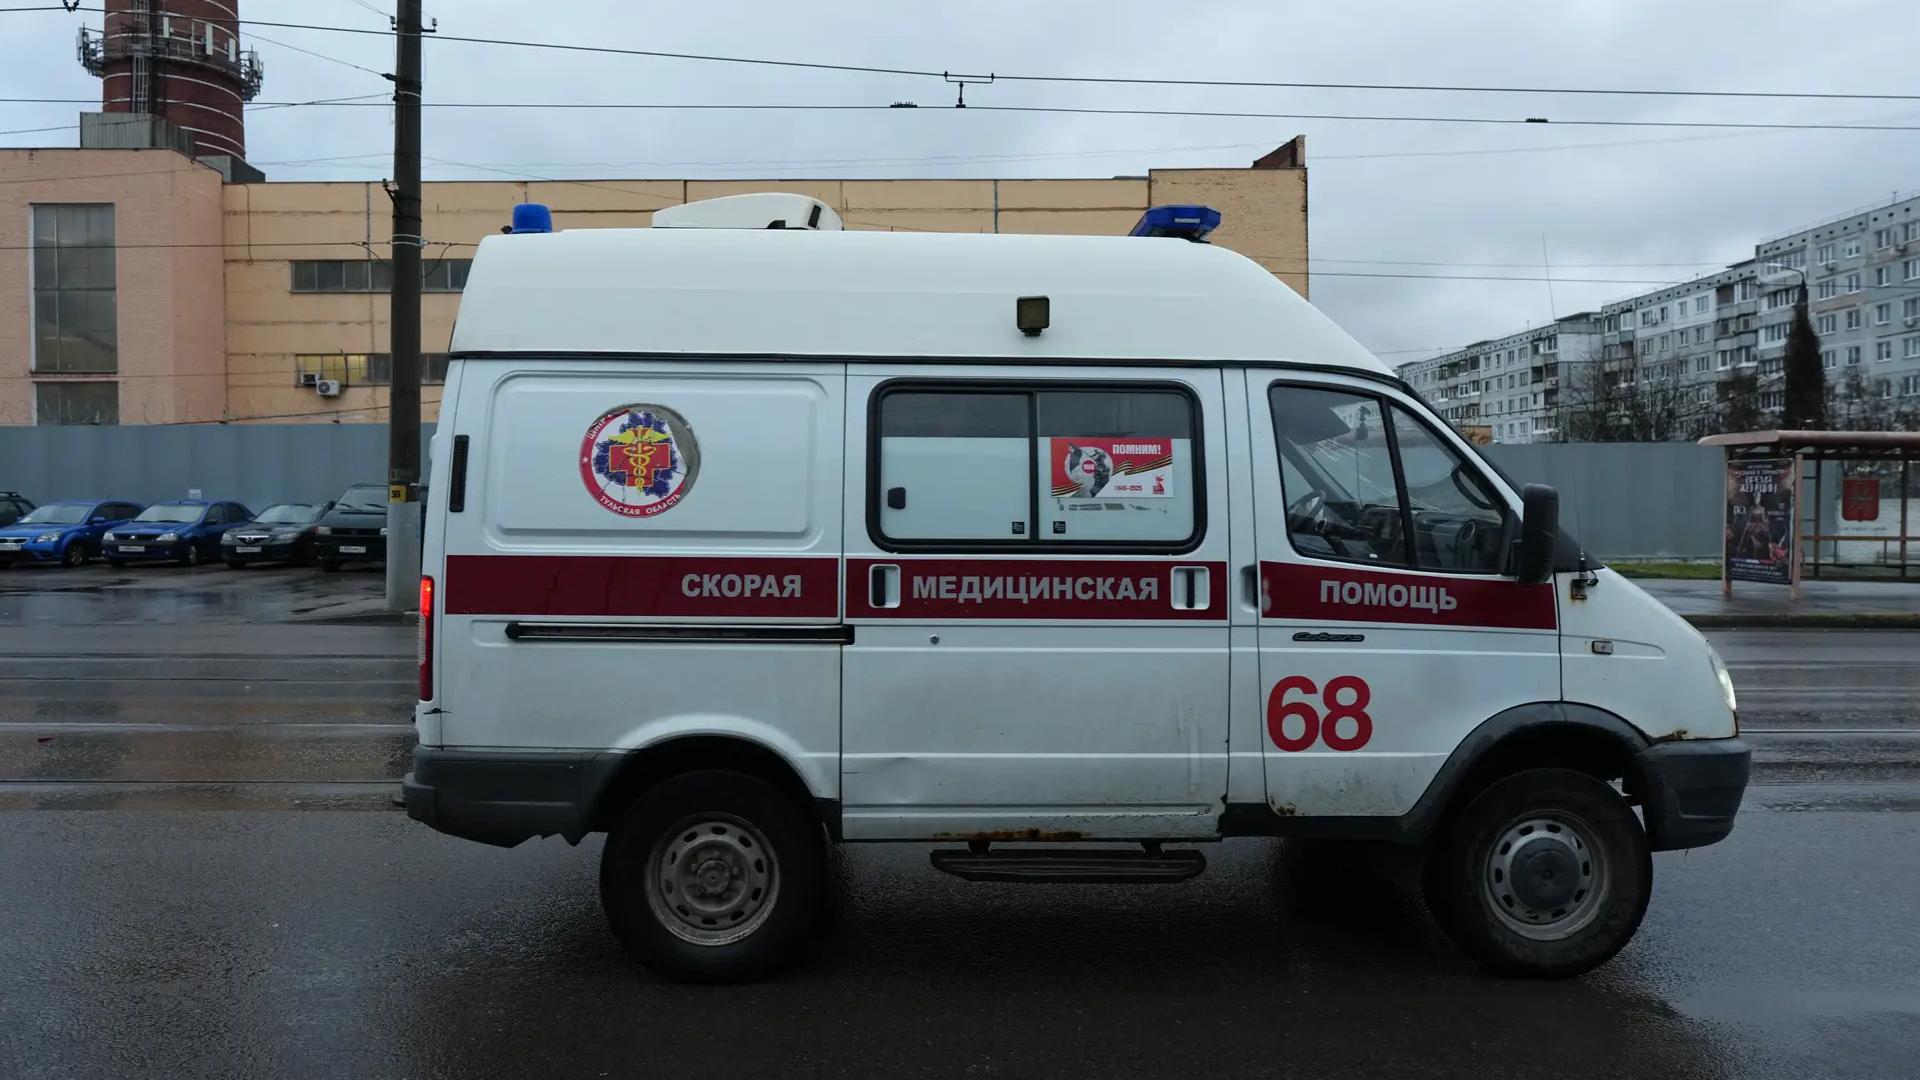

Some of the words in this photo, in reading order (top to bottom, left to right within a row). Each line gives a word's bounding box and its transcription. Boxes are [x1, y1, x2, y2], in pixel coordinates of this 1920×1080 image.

[1112, 444, 1161, 455] ПОМНИМ!
[600, 495, 640, 515] ТУЛЬСКАЯ
[645, 494, 681, 514] ОБЛАСТЬ
[681, 573, 801, 598] СКОРАЯ
[912, 575, 1158, 604] МЕДИЦИНСКАЯ
[1320, 579, 1458, 614] ПОМОЩЬ
[1267, 675, 1373, 752] 68
